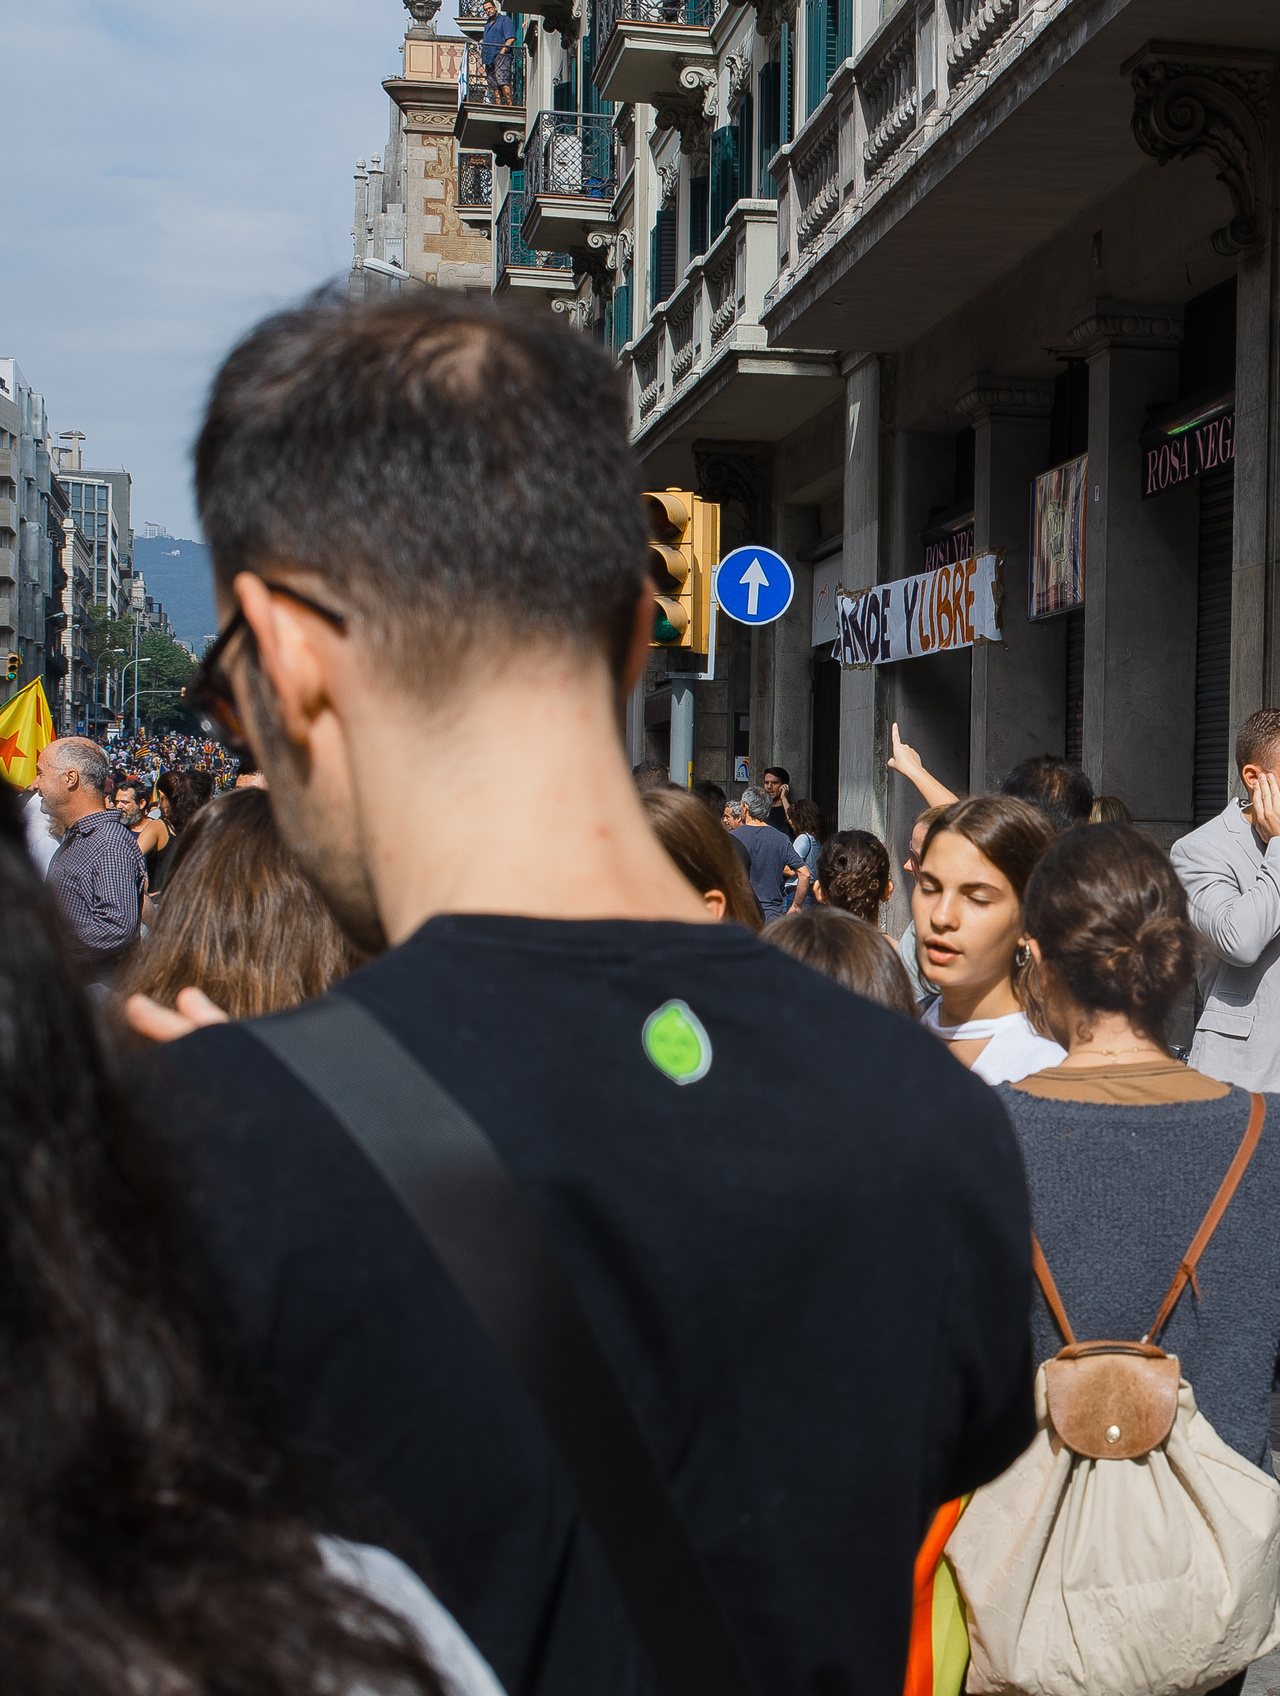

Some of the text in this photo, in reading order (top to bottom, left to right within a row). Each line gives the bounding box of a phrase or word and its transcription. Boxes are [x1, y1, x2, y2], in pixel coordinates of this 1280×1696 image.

[1146, 435, 1190, 495] ROSA
[925, 539, 949, 573] ROSA
[832, 589, 892, 664] ANDE
[918, 558, 978, 652] LIBRE
